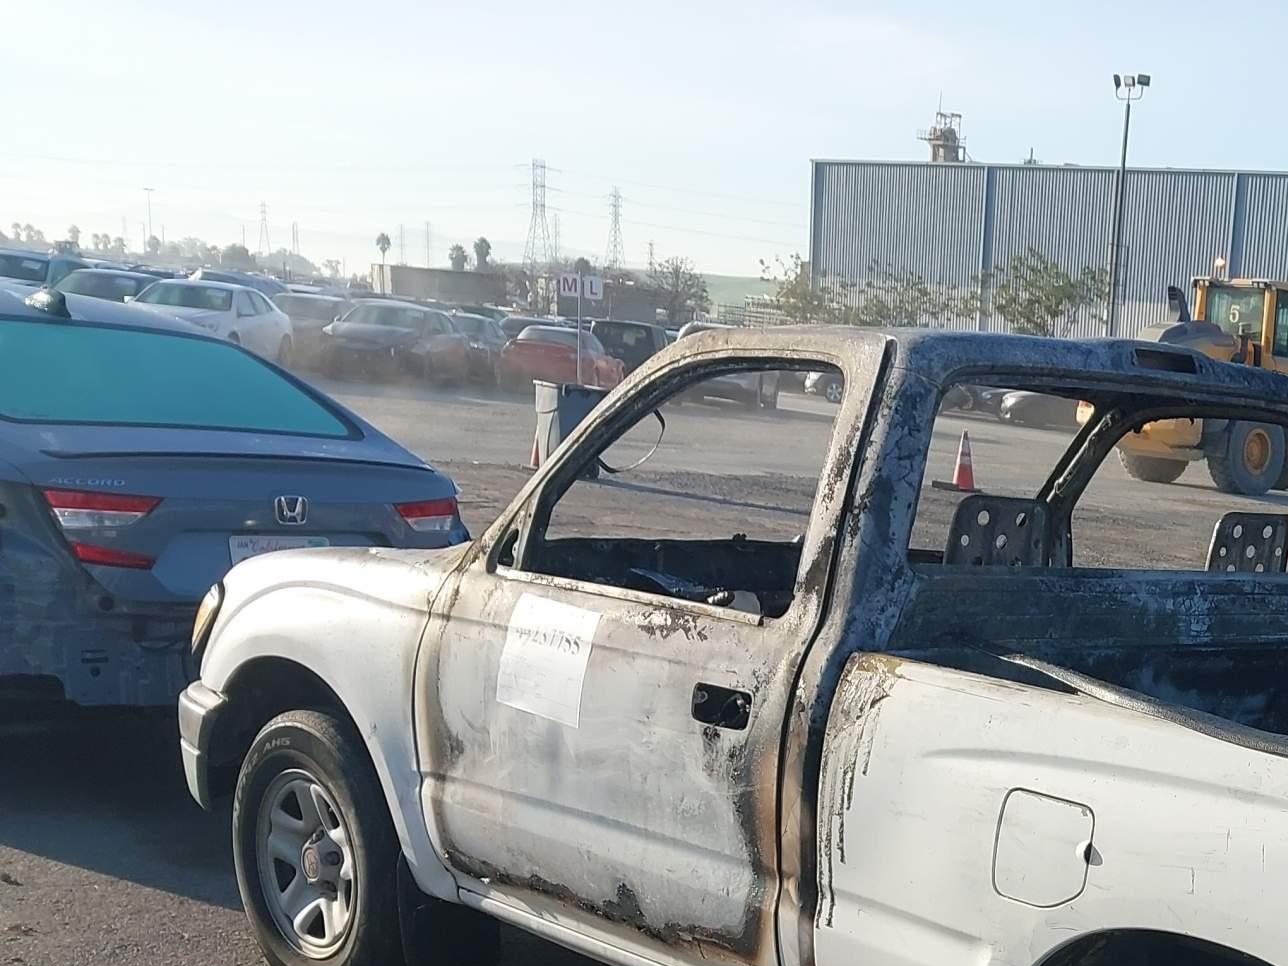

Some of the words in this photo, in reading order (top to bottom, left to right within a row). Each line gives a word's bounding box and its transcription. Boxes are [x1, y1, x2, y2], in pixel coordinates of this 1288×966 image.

[562, 276, 577, 293] M
[590, 280, 598, 296] L
[1229, 304, 1240, 323] 5
[48, 477, 126, 487] ACCORD
